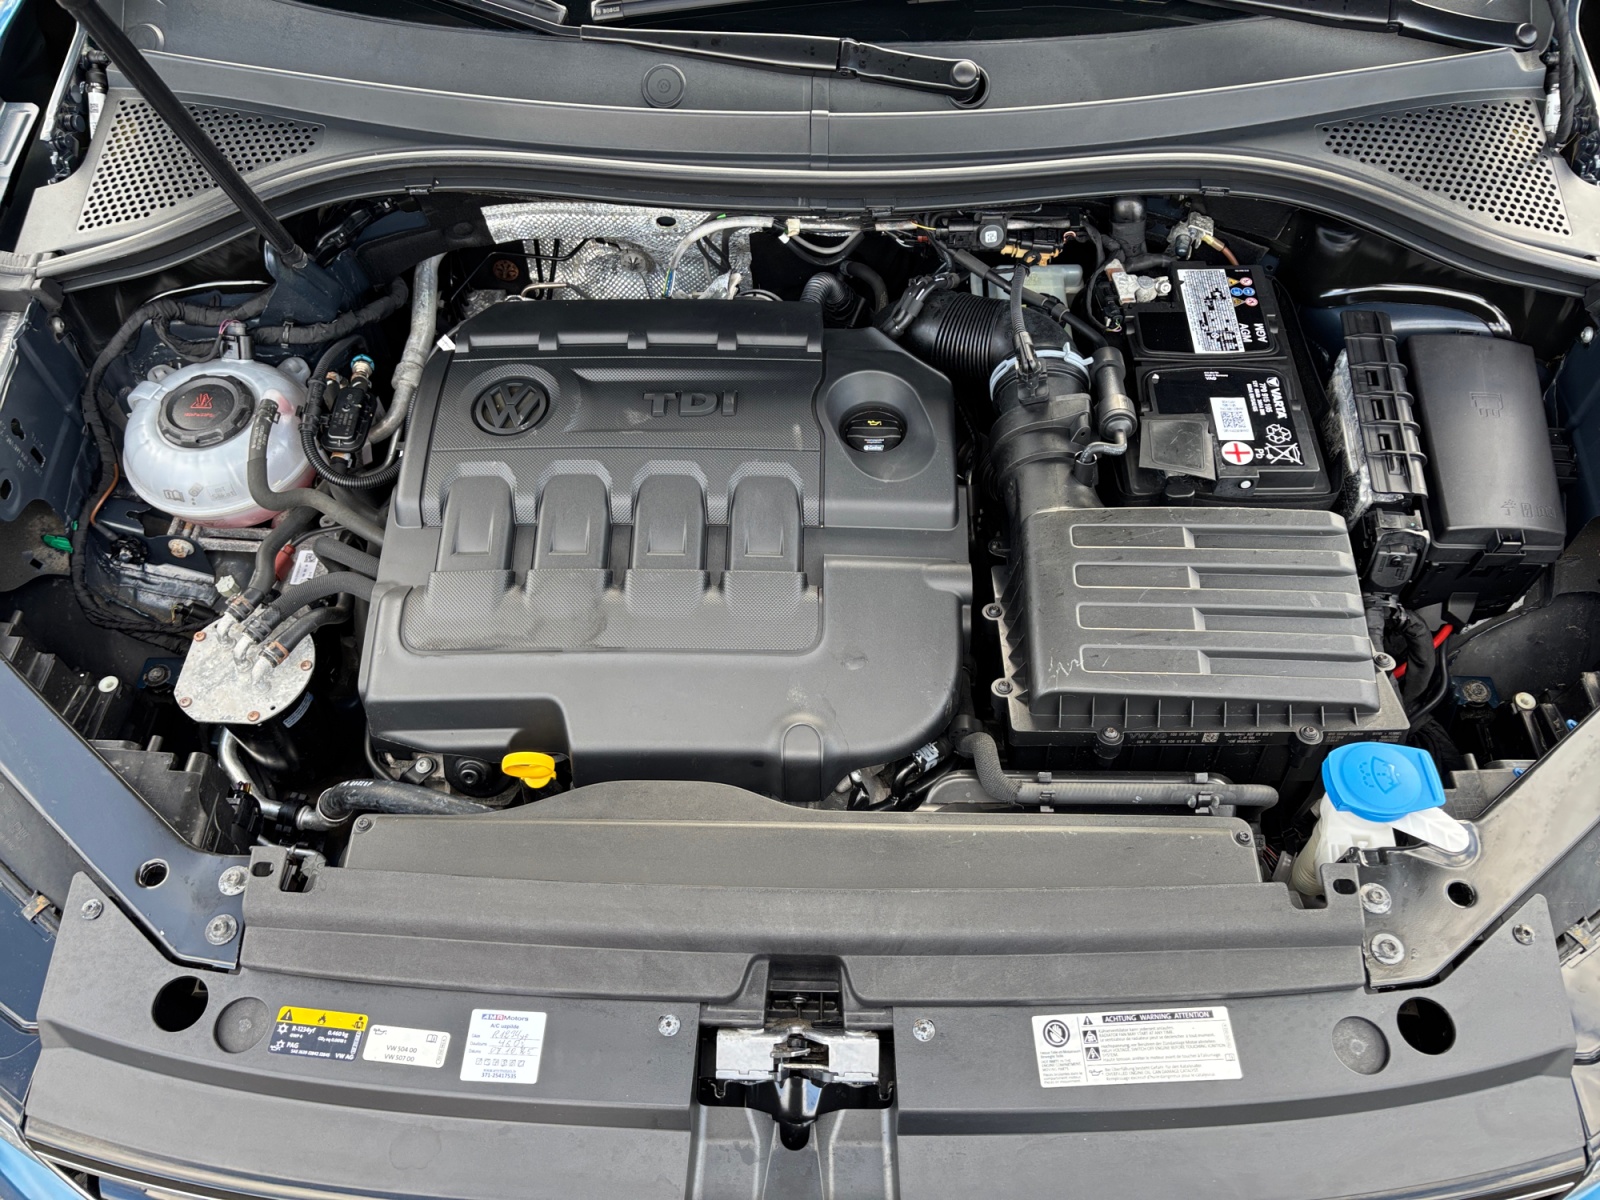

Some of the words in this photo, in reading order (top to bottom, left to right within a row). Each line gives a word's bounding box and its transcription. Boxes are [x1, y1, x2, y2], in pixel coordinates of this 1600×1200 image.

[1239, 323, 1253, 343] AGM
[1253, 323, 1268, 343] AGM
[643, 389, 738, 418] TDI
[1270, 387, 1288, 419] VARTA
[1254, 448, 1265, 459] Pb
[1105, 1014, 1137, 1022] ACHTUNG
[1140, 1012, 1172, 1021] WARNING
[1174, 1011, 1210, 1019] ATTENTION
[291, 1025, 317, 1035] R-1234yf
[286, 1041, 299, 1049] PAG
